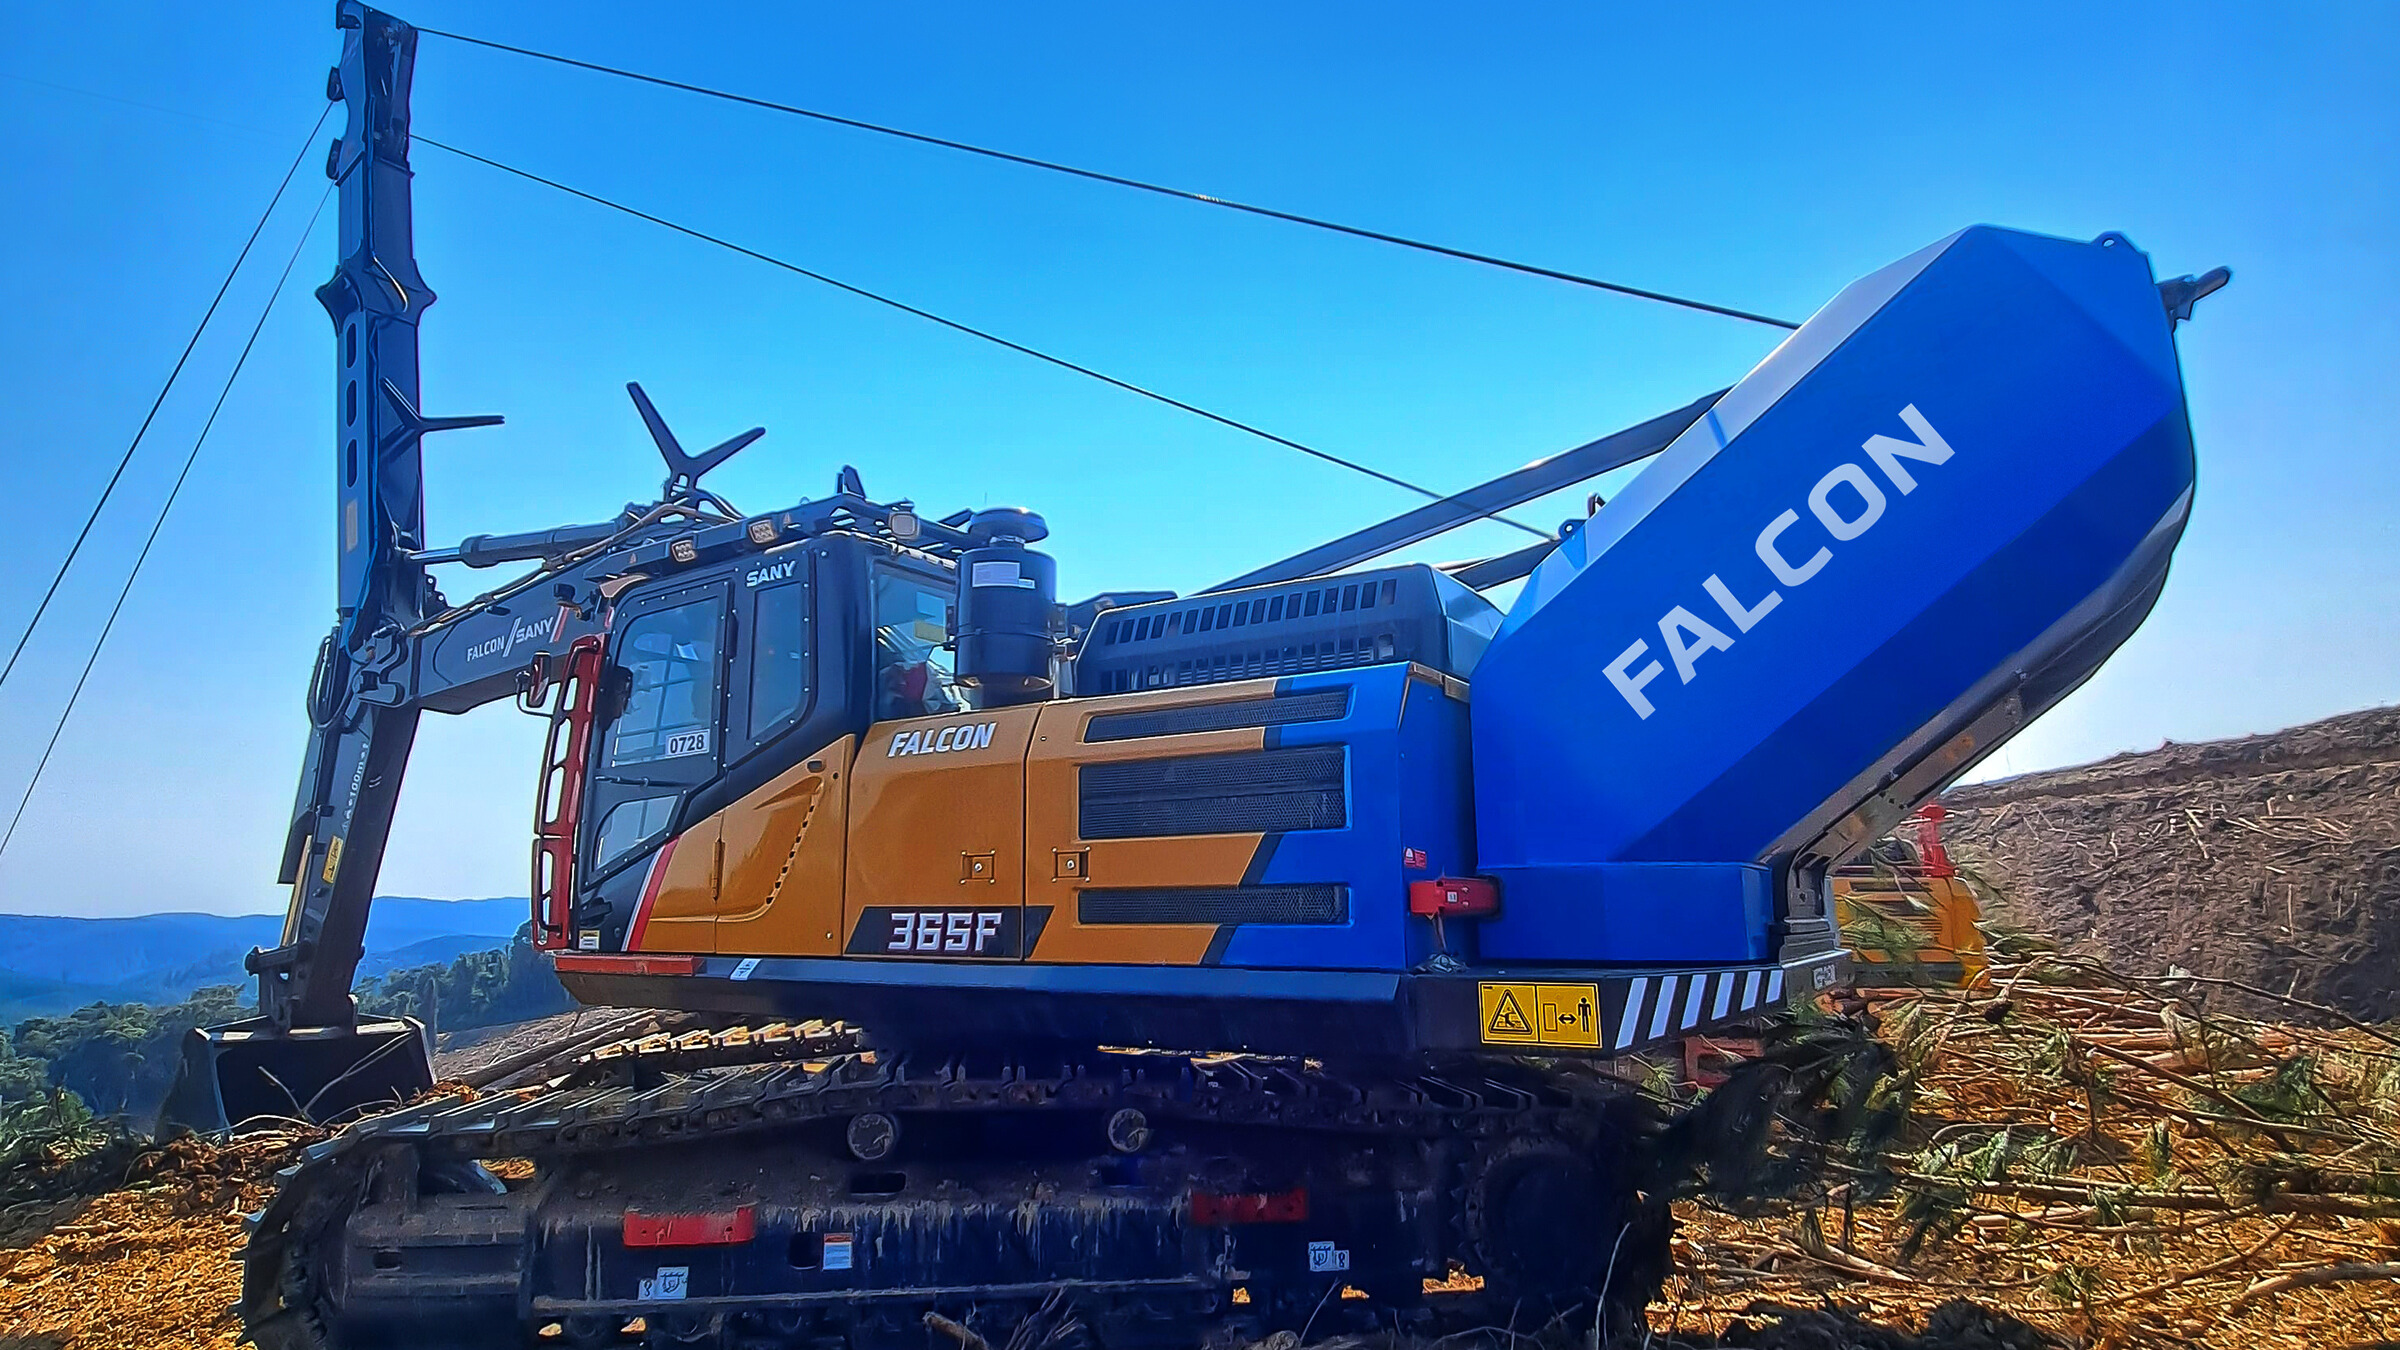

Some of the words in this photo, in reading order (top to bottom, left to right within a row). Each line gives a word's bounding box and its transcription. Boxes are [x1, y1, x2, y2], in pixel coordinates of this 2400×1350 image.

[746, 560, 796, 588] SANY
[1602, 403, 1955, 720] FALCON
[466, 635, 505, 662] FALCON
[515, 616, 554, 644] SANY
[670, 734, 704, 754] 0728
[887, 722, 997, 757] FALCON
[887, 912, 1002, 951] 365F
